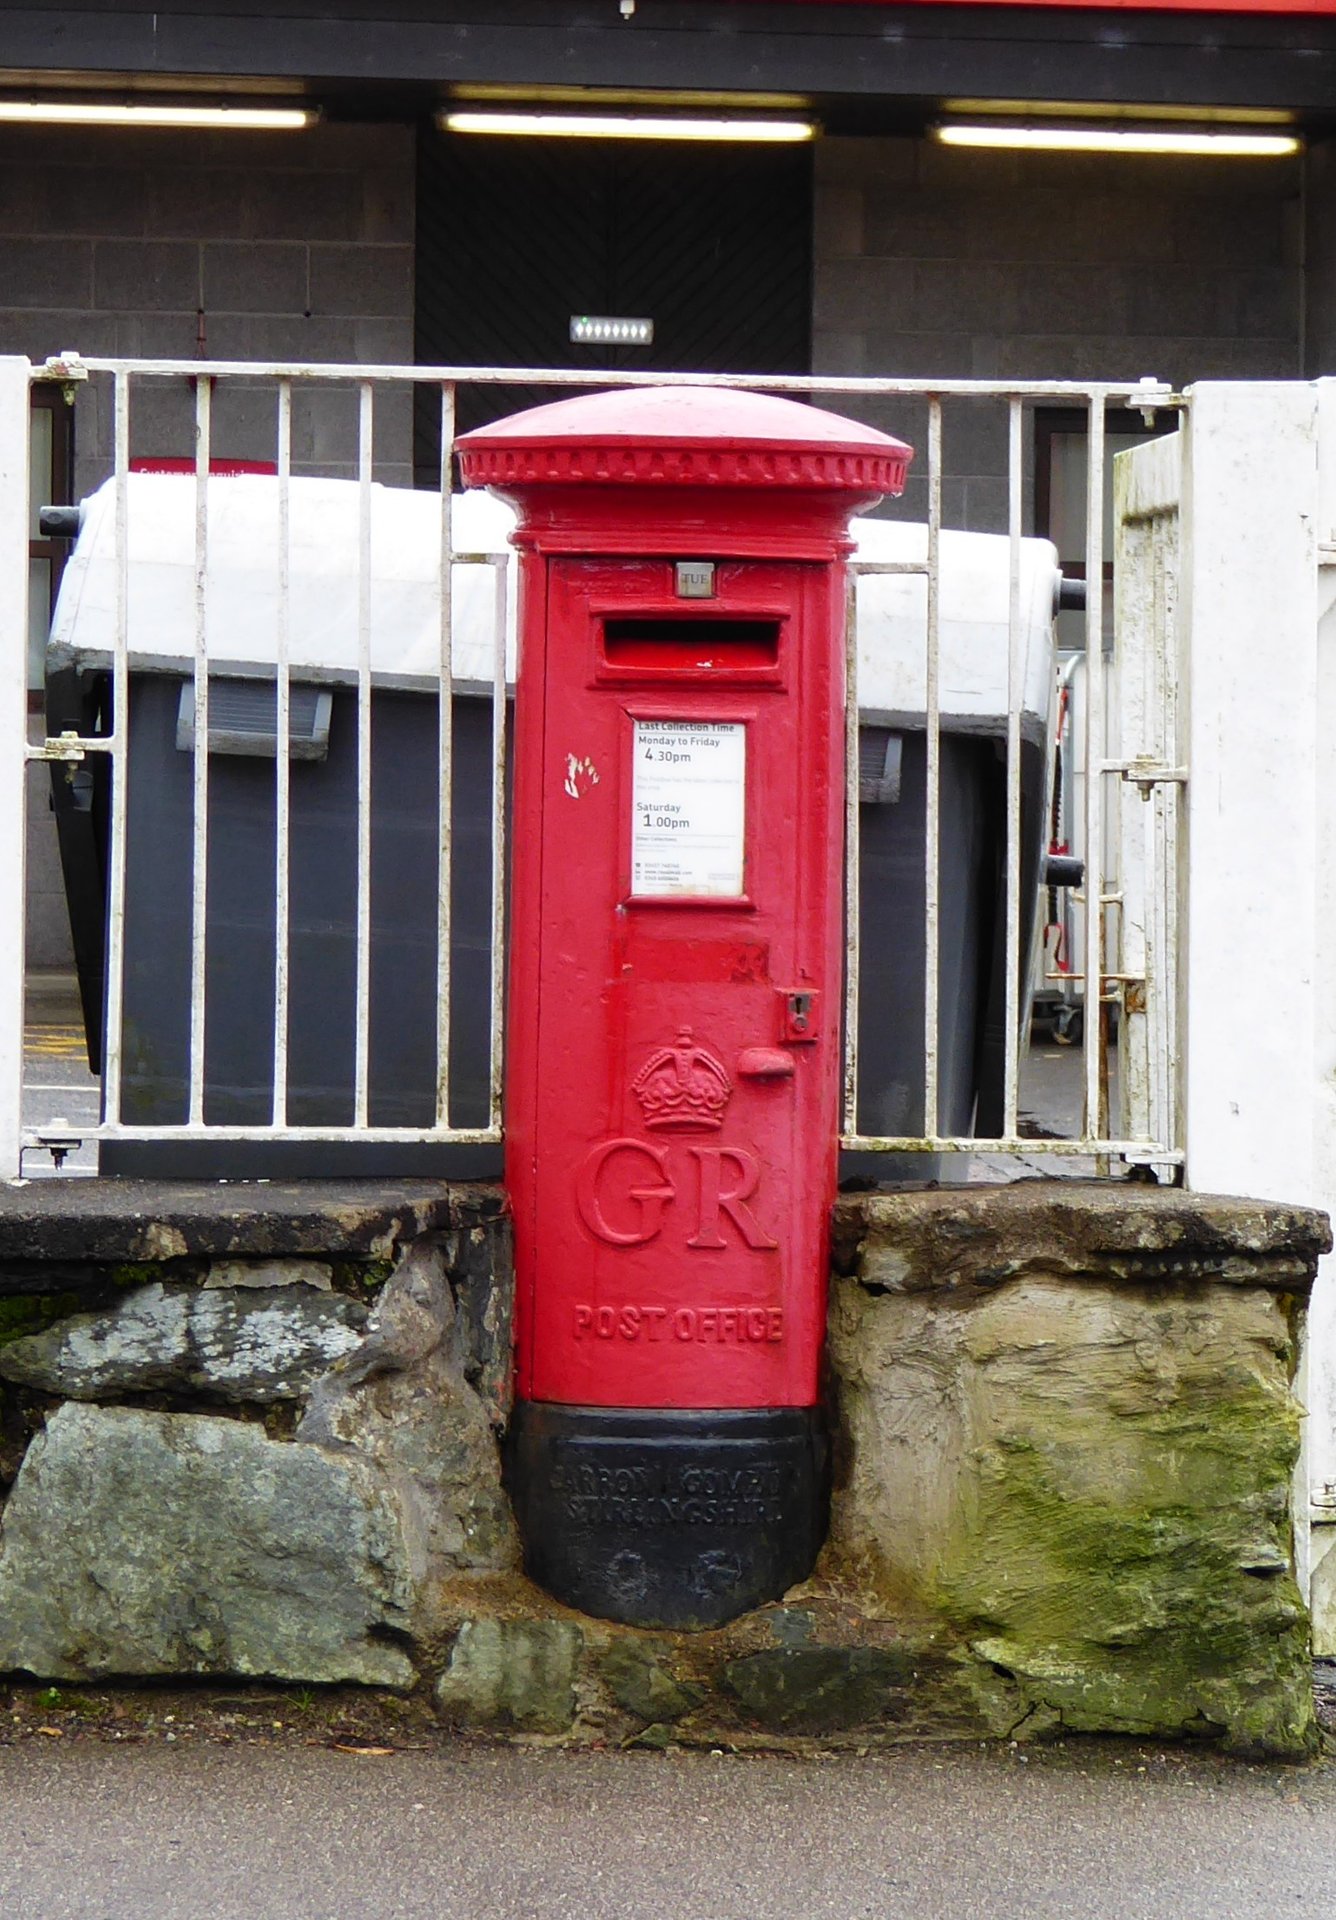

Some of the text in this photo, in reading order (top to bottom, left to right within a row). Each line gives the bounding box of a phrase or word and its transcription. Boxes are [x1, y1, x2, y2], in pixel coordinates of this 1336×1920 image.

[681, 573, 709, 585] TUE
[638, 722, 735, 733] Last Collection Time
[638, 736, 720, 747] Monday to Friday
[637, 802, 681, 813] Saturday
[575, 1136, 779, 1250] GR
[572, 1303, 784, 1344] POST OFFICE
